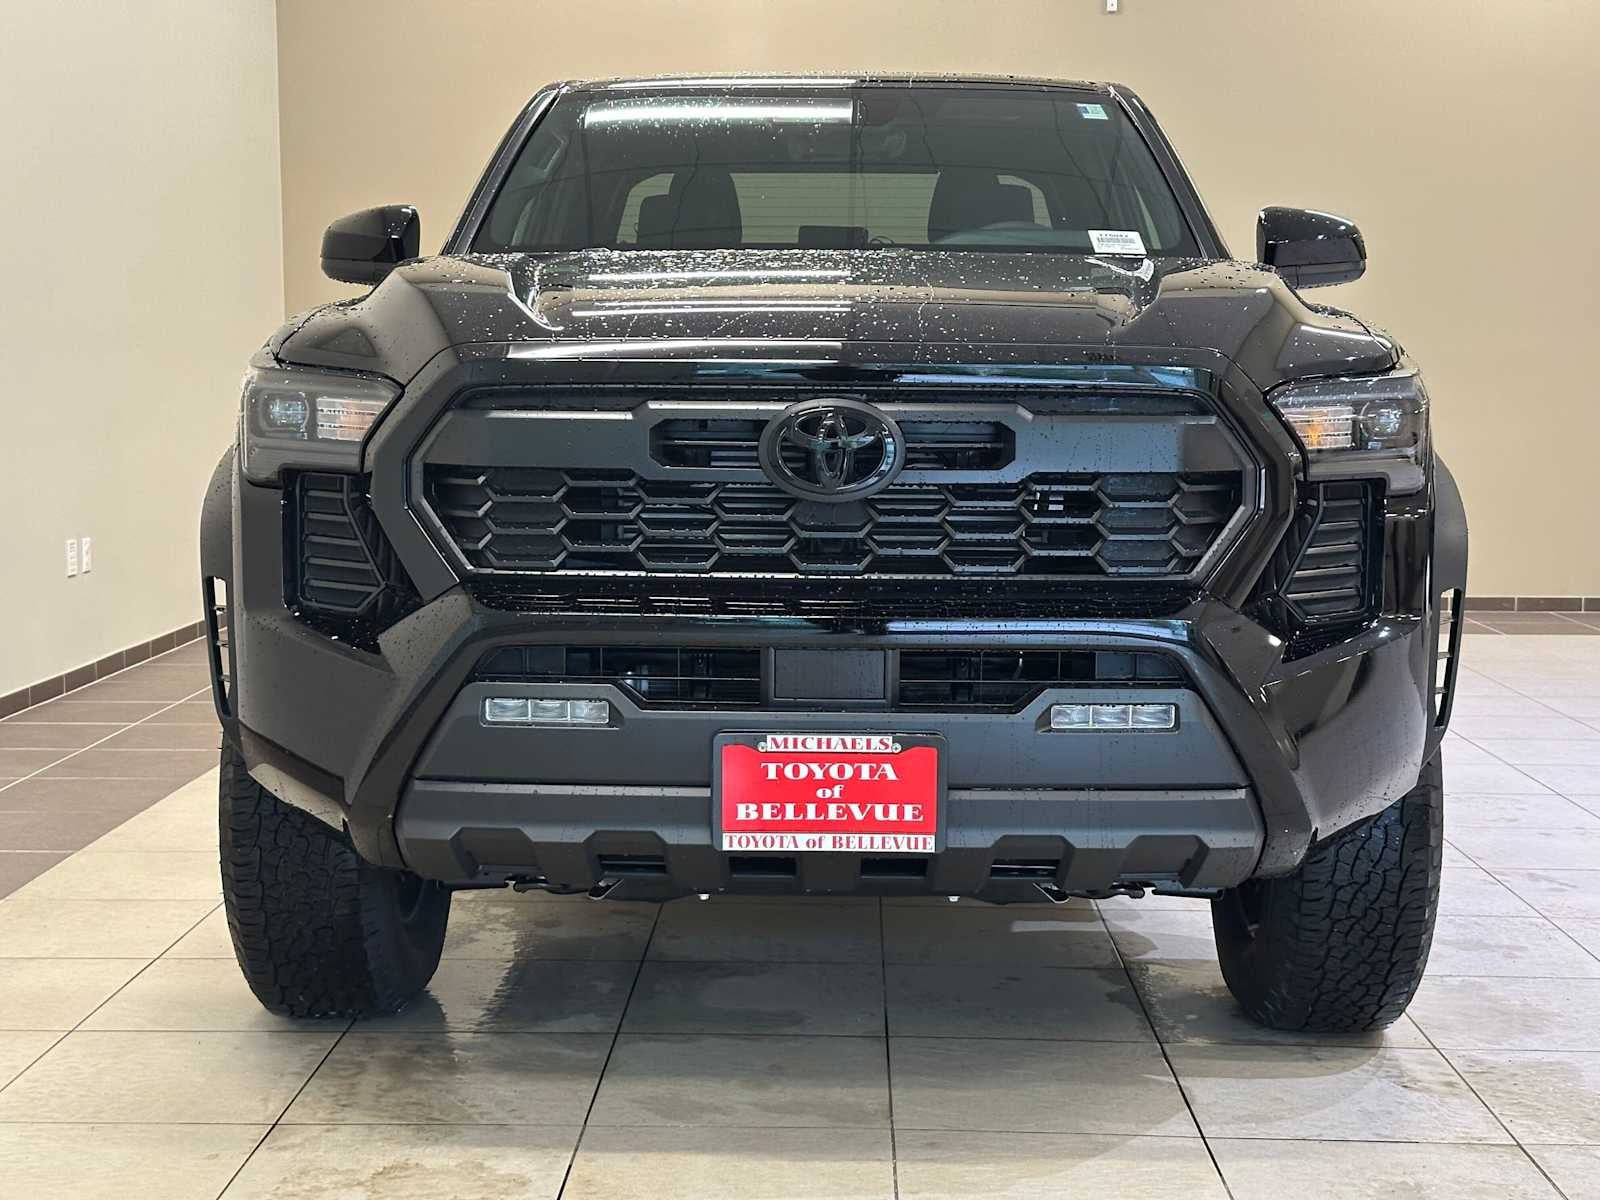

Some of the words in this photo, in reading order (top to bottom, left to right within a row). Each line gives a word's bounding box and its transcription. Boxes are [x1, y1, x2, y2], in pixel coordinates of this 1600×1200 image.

[770, 737, 890, 750] MICHAELS
[761, 762, 899, 781] TOYOTA
[816, 784, 845, 799] of
[735, 802, 924, 822] BELLEVUE
[724, 834, 799, 849] TOYOTA
[806, 834, 825, 849] of
[832, 835, 934, 850] BELLEVUE
